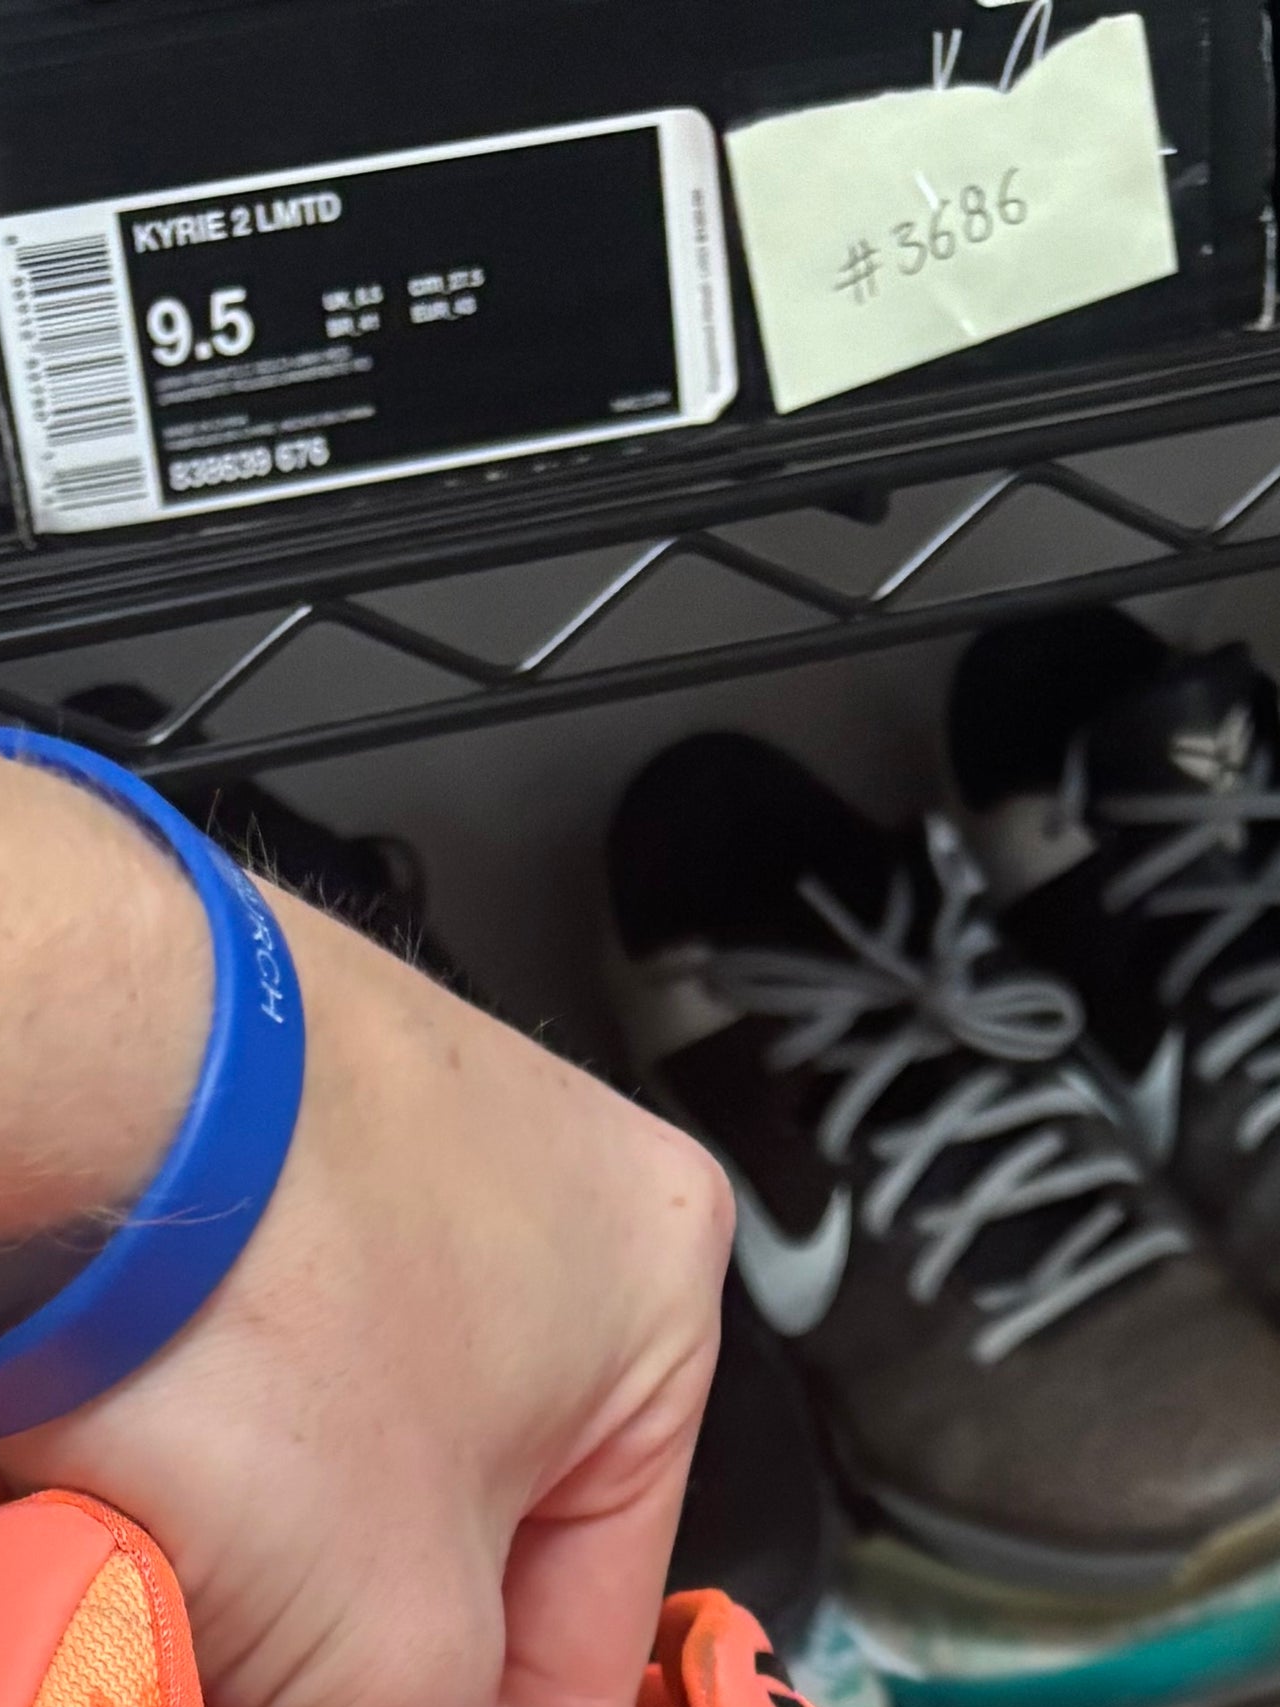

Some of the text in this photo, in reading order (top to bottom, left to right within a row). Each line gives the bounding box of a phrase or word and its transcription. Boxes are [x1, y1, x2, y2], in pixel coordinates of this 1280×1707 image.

[131, 190, 344, 255] KYRIE 2 LMTD
[832, 165, 1029, 306] #3686
[144, 286, 256, 367] 9.5
